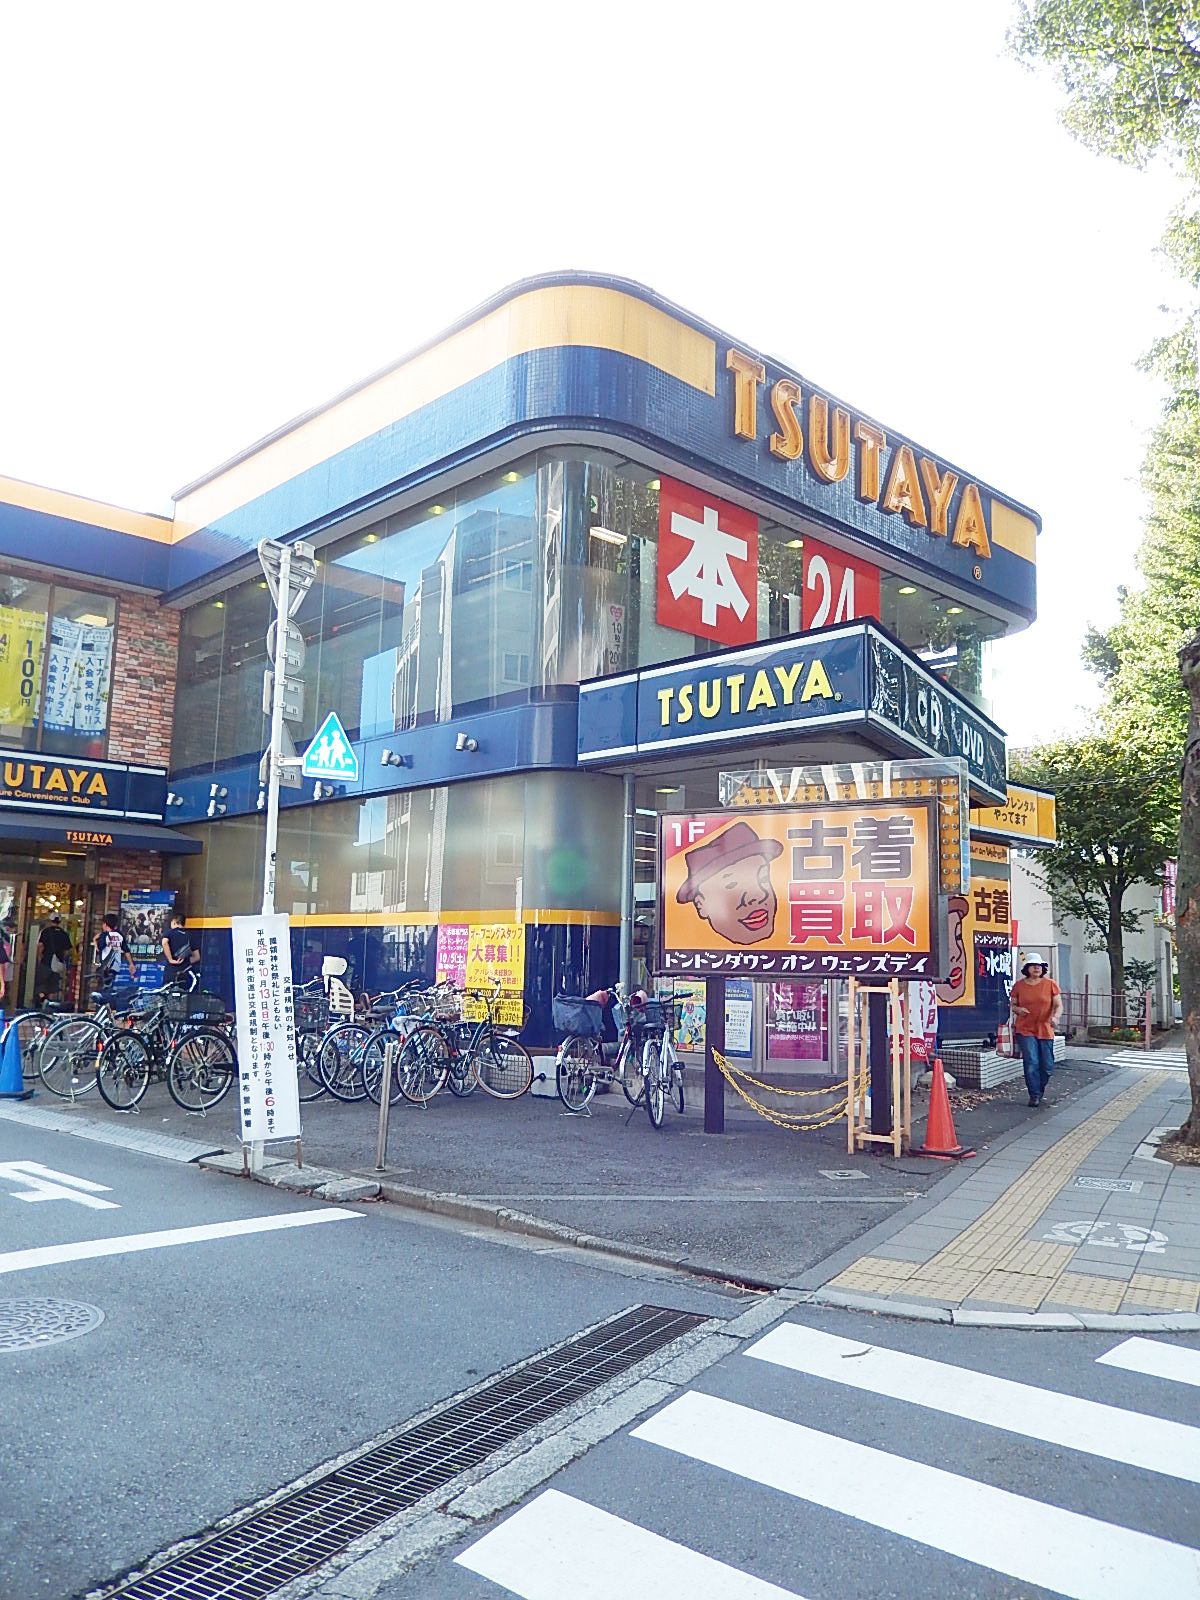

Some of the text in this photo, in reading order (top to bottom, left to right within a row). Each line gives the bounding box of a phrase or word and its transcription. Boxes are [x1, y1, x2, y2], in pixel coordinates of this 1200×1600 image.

[726, 347, 991, 559] TSUTAYA
[667, 506, 750, 627] 本
[84, 656, 95, 725] 入会受付中!!
[657, 659, 834, 727] TSUTAYA
[961, 721, 985, 767] DVD
[4, 761, 108, 796] UTAYA
[14, 789, 69, 802] Convenience
[71, 795, 91, 804] Club
[671, 821, 706, 848] 1F
[993, 808, 1028, 827] やってます
[66, 831, 113, 844] TSUTAYA
[786, 815, 915, 881] 古着
[787, 881, 916, 946] 買取
[973, 887, 1010, 925] 古着
[470, 926, 523, 940] オープニングスタッフ
[471, 944, 520, 963] 大募集!!
[665, 952, 928, 972] ドンドンダウン オン ウェンズデイ
